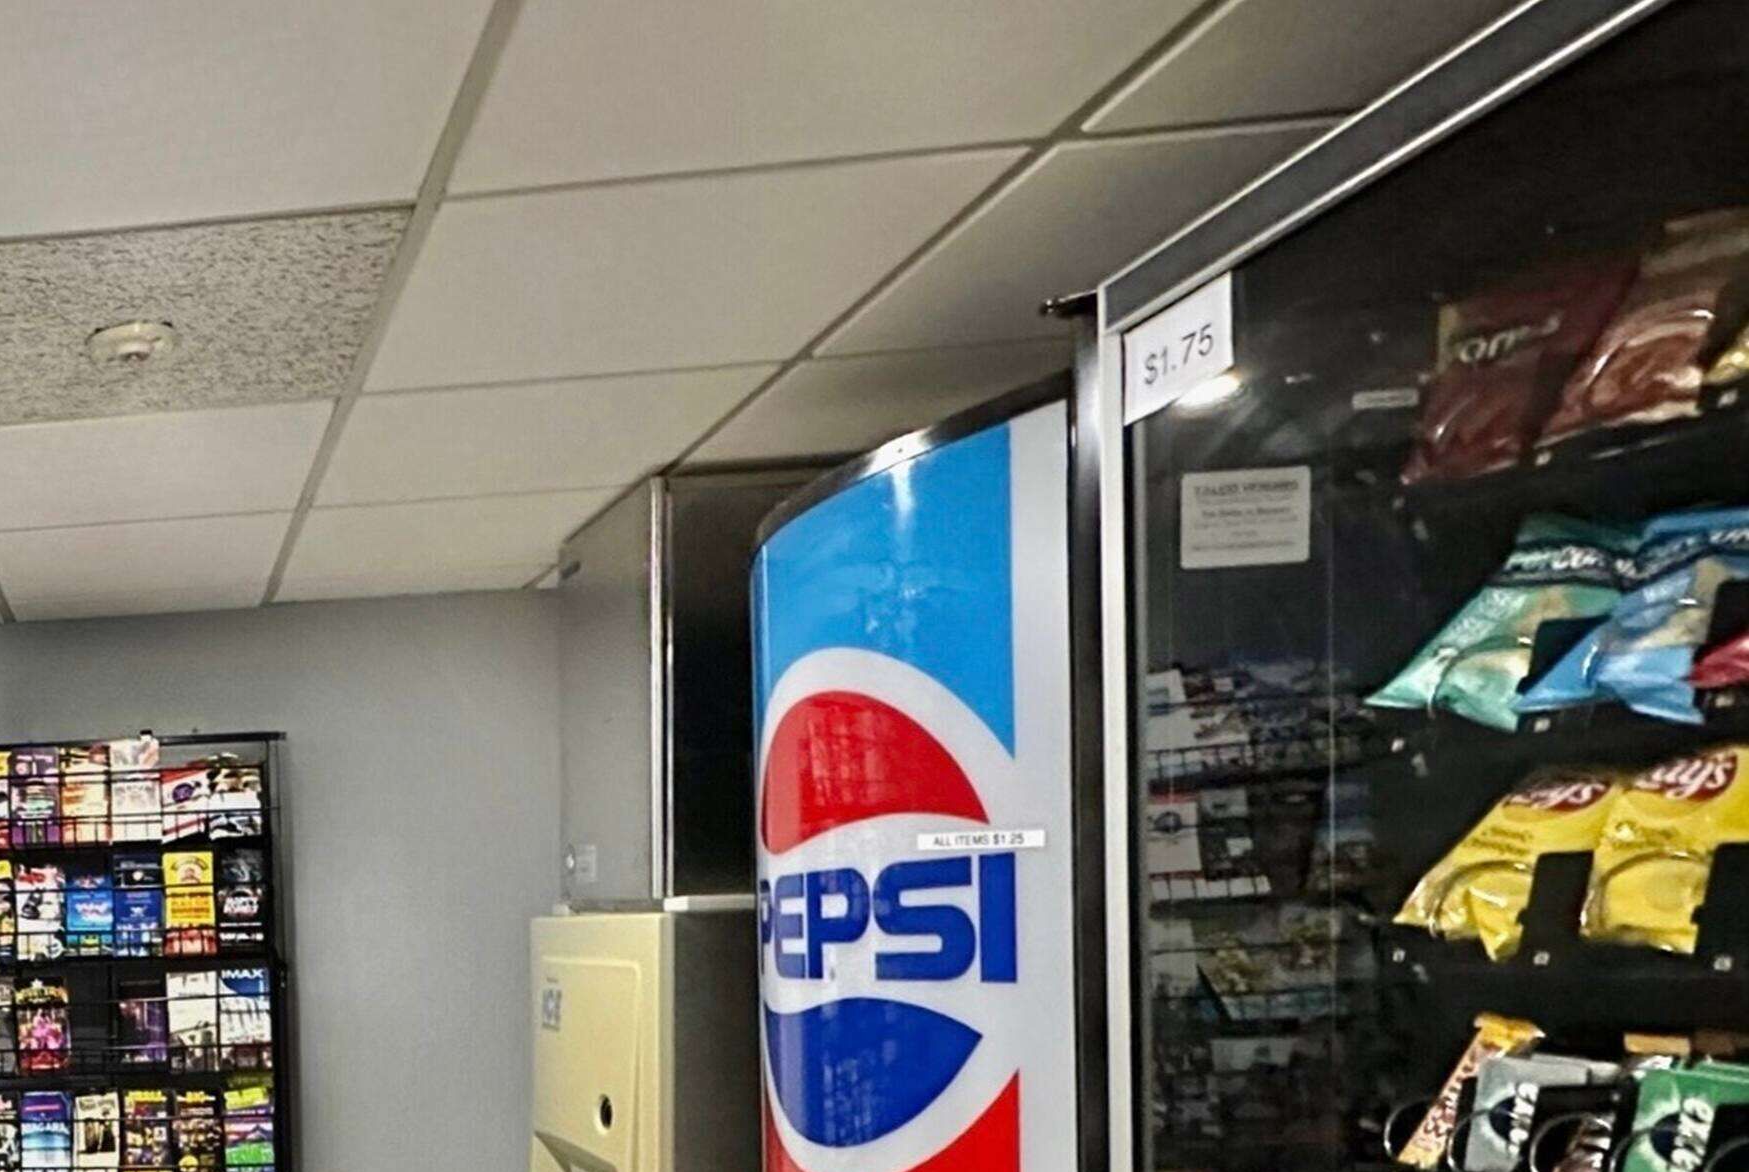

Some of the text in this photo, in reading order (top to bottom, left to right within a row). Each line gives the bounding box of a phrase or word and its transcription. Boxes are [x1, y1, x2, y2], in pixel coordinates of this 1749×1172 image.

[1143, 322, 1214, 386] $1.75
[933, 835, 952, 847] ALL
[955, 833, 990, 846] ITEMS
[221, 968, 264, 980] IMAX
